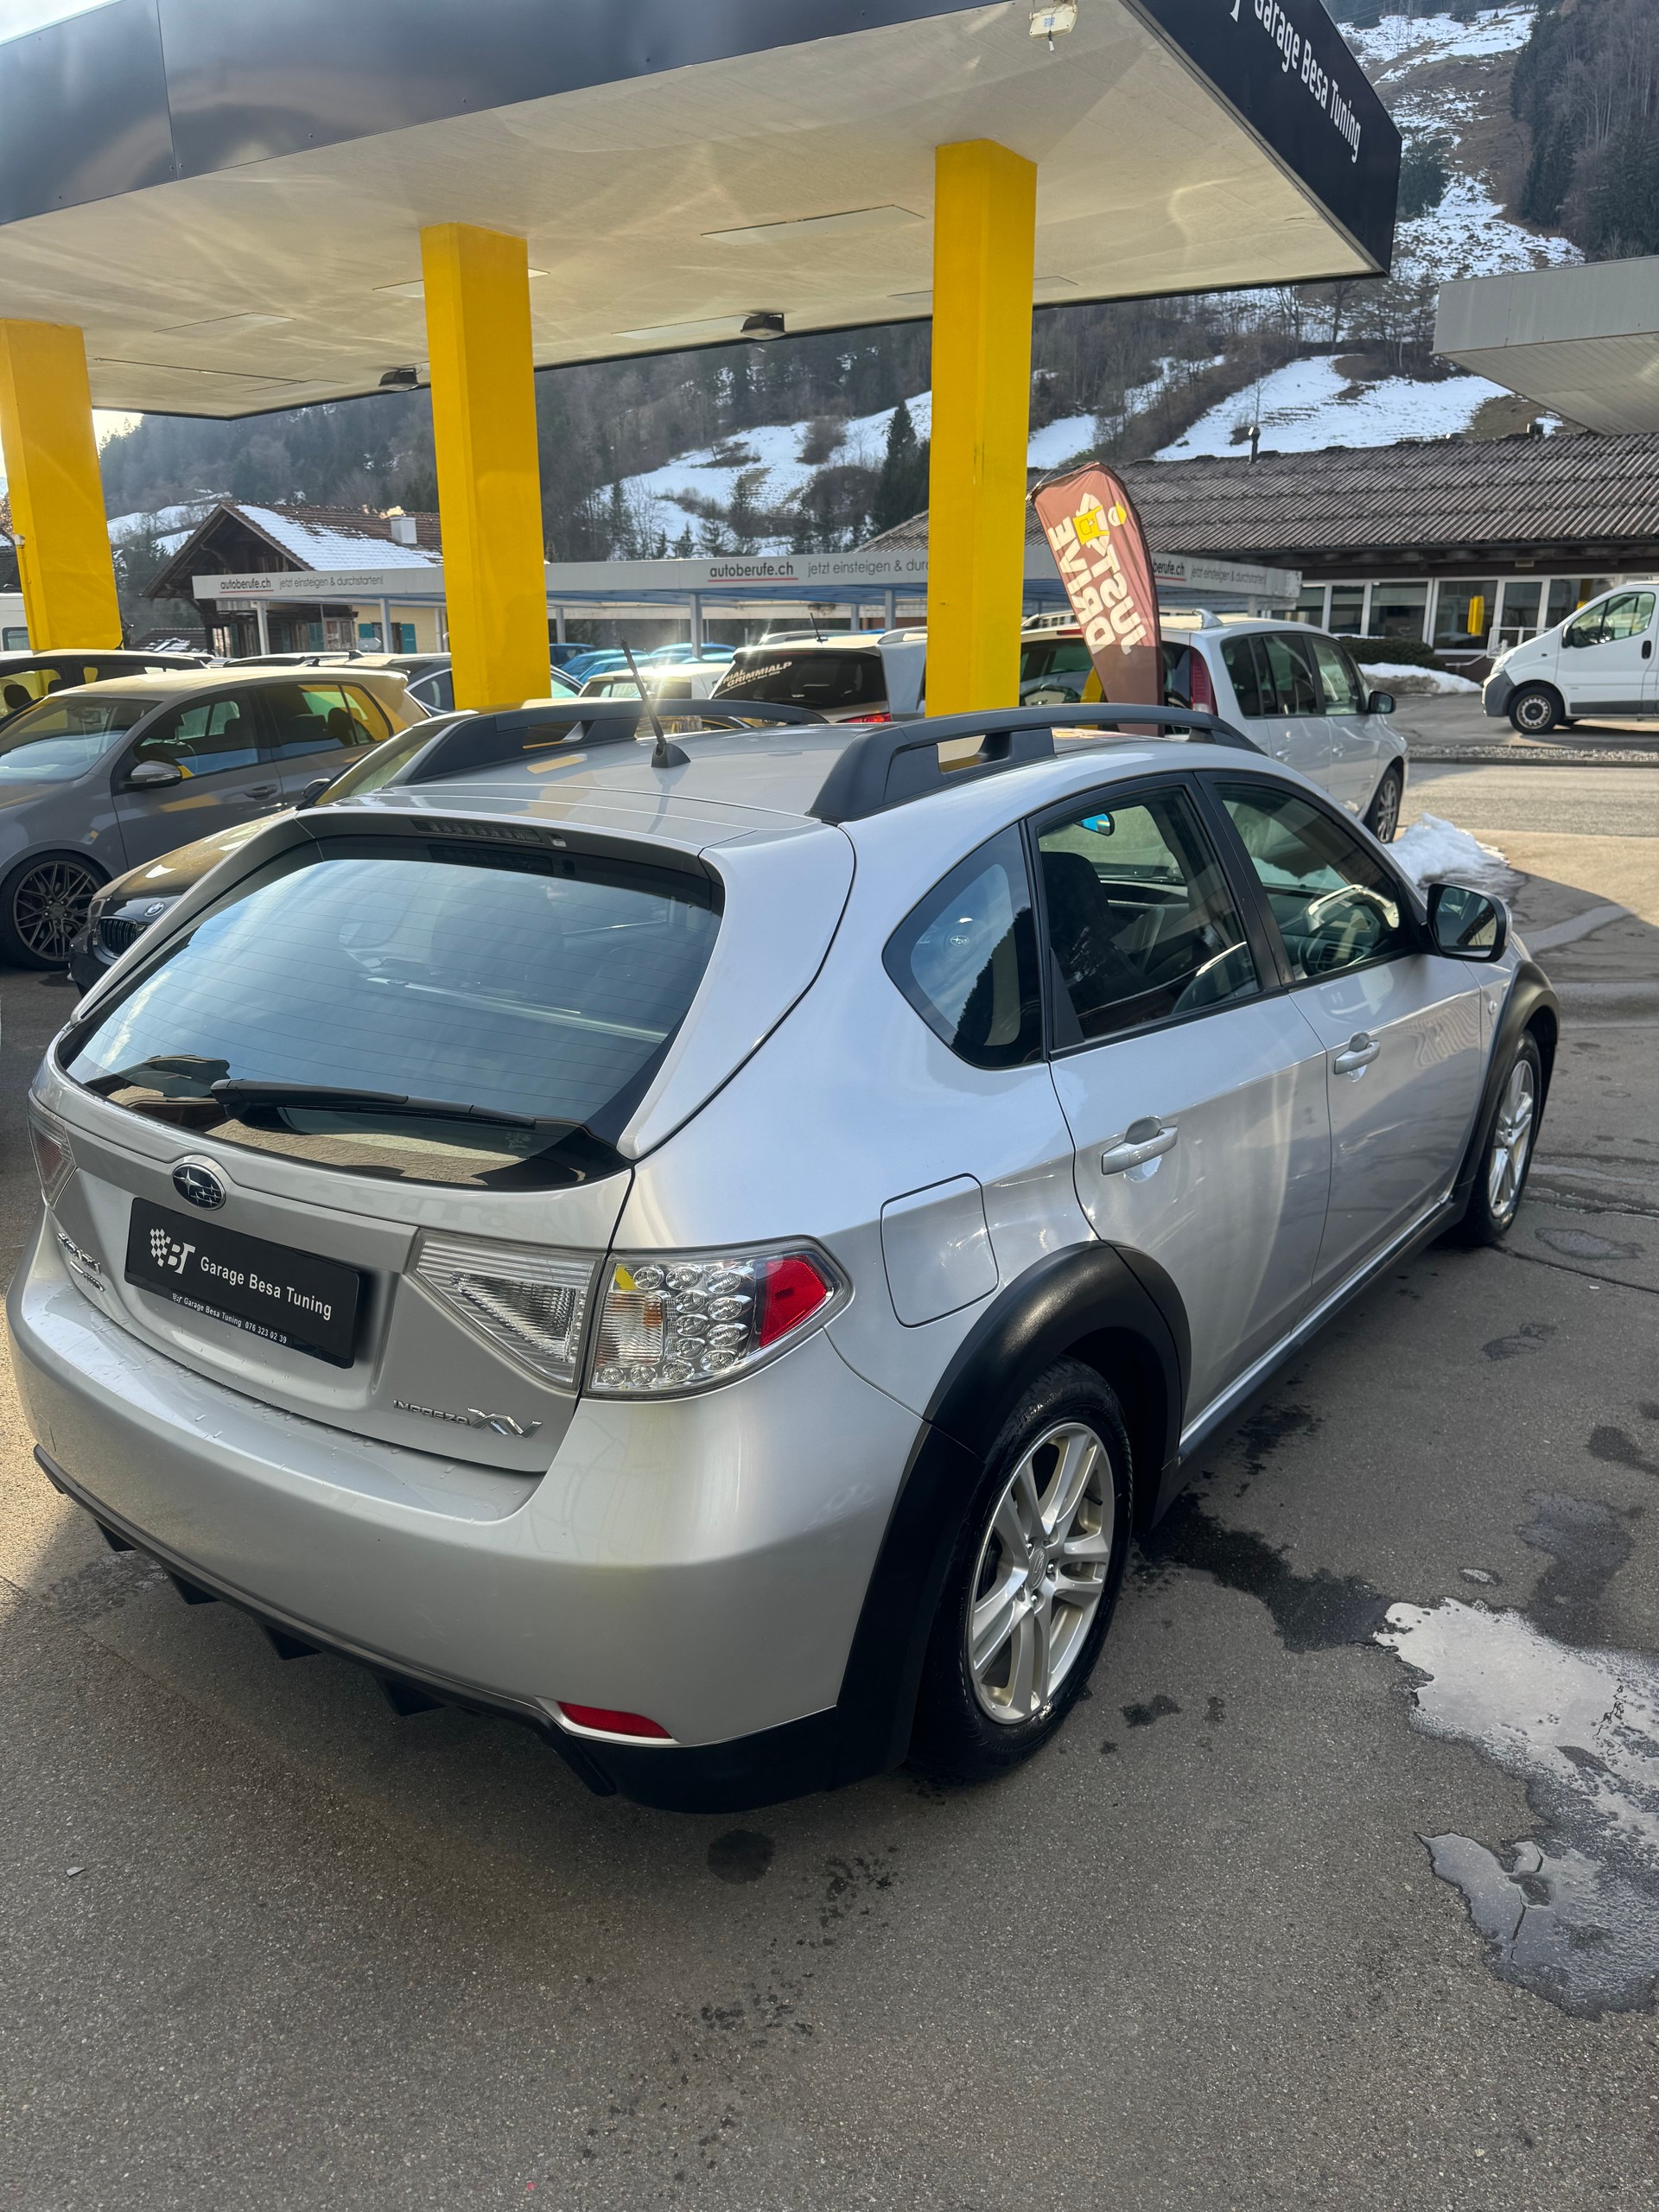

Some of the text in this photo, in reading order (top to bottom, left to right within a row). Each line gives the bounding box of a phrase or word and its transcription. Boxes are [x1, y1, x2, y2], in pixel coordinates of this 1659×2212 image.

[1300, 39, 1329, 110] Besa
[1330, 79, 1362, 163] Tuning
[709, 562, 794, 577] autoberufe.ch
[807, 563, 830, 577] jetzt
[832, 560, 891, 575] einsteigen
[893, 559, 903, 572] &
[1153, 559, 1185, 576] berufe.ch
[220, 578, 271, 589] autoberufe.ch
[727, 661, 792, 688] GRIMMIALP
[200, 1256, 332, 1321] Garage Besa Tuning
[183, 1297, 204, 1312] Garage
[206, 1306, 219, 1318] Besa
[221, 1312, 242, 1327] Tuning
[245, 1321, 256, 1332] 076
[257, 1325, 269, 1337] 323
[270, 1331, 277, 1341] 02
[279, 1334, 287, 1344] 39
[393, 1399, 469, 1426] IMPREZA
